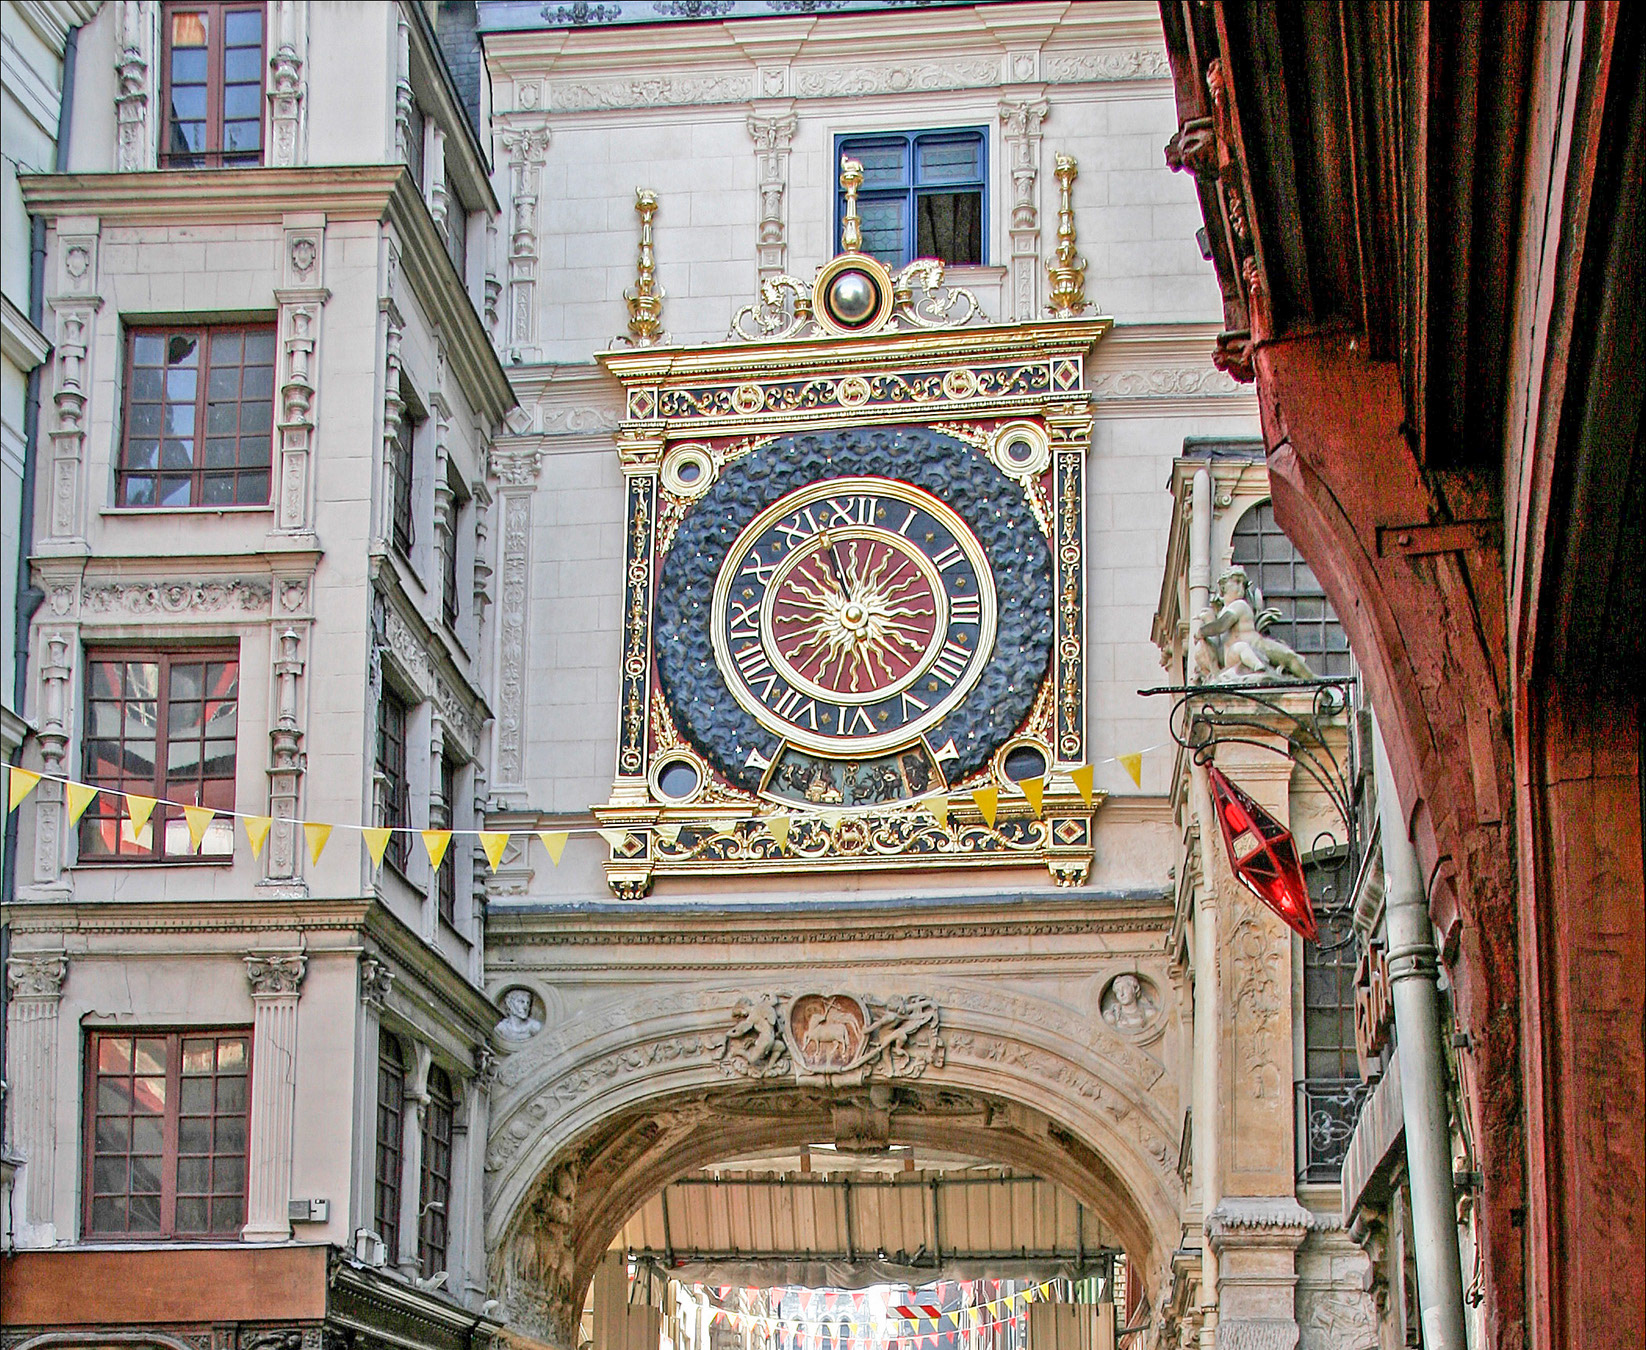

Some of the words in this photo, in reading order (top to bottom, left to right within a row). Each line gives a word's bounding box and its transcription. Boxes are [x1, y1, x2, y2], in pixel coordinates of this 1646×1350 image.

[774, 508, 822, 551] XI
[827, 497, 878, 528] XII
[899, 508, 918, 536] I
[740, 550, 779, 586] X
[931, 543, 966, 573] II
[730, 601, 761, 640] IX
[949, 593, 980, 625] III
[733, 643, 780, 703] VIII
[929, 641, 973, 688] IIII
[772, 686, 820, 731] VII
[836, 705, 878, 736] VI
[900, 691, 930, 723] V
